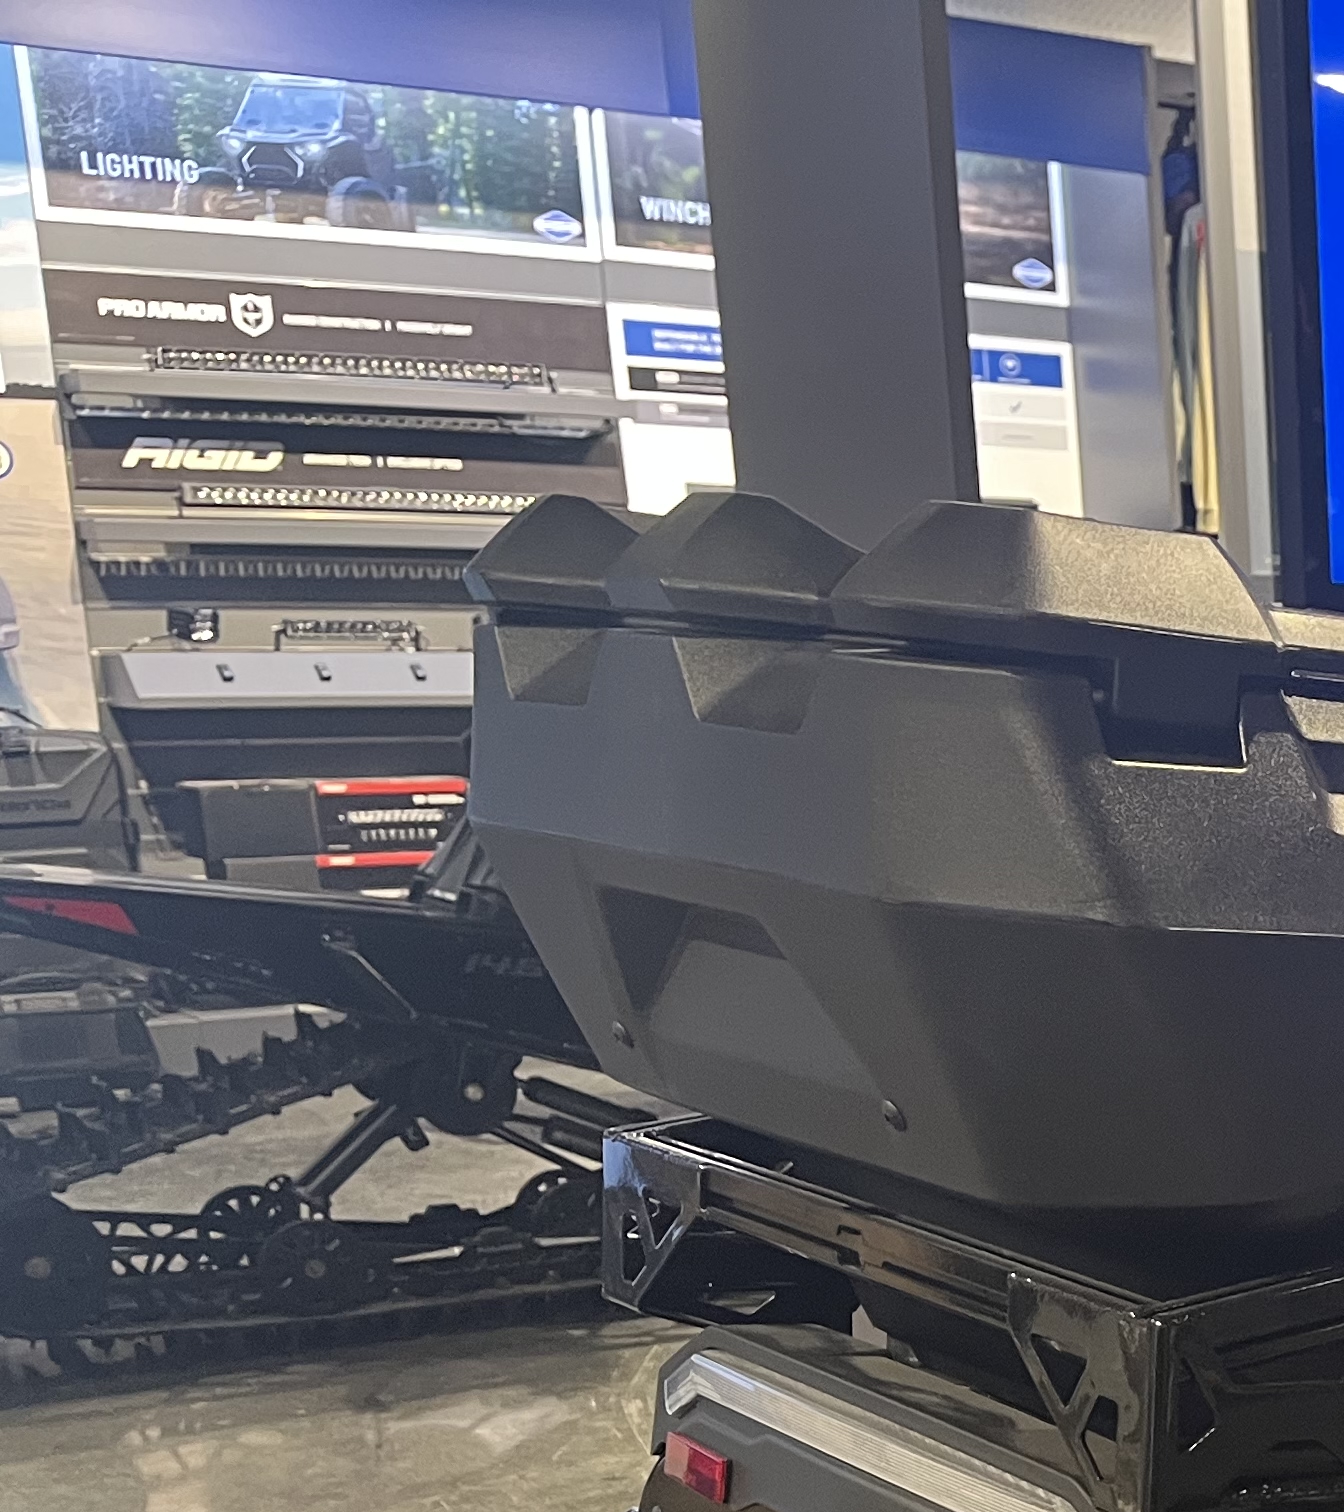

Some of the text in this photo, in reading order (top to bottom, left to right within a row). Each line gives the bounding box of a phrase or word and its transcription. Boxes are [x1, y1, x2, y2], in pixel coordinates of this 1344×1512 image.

[80, 151, 200, 184] LIGHTING
[97, 297, 146, 318] PRO
[121, 437, 285, 472] RIGID
